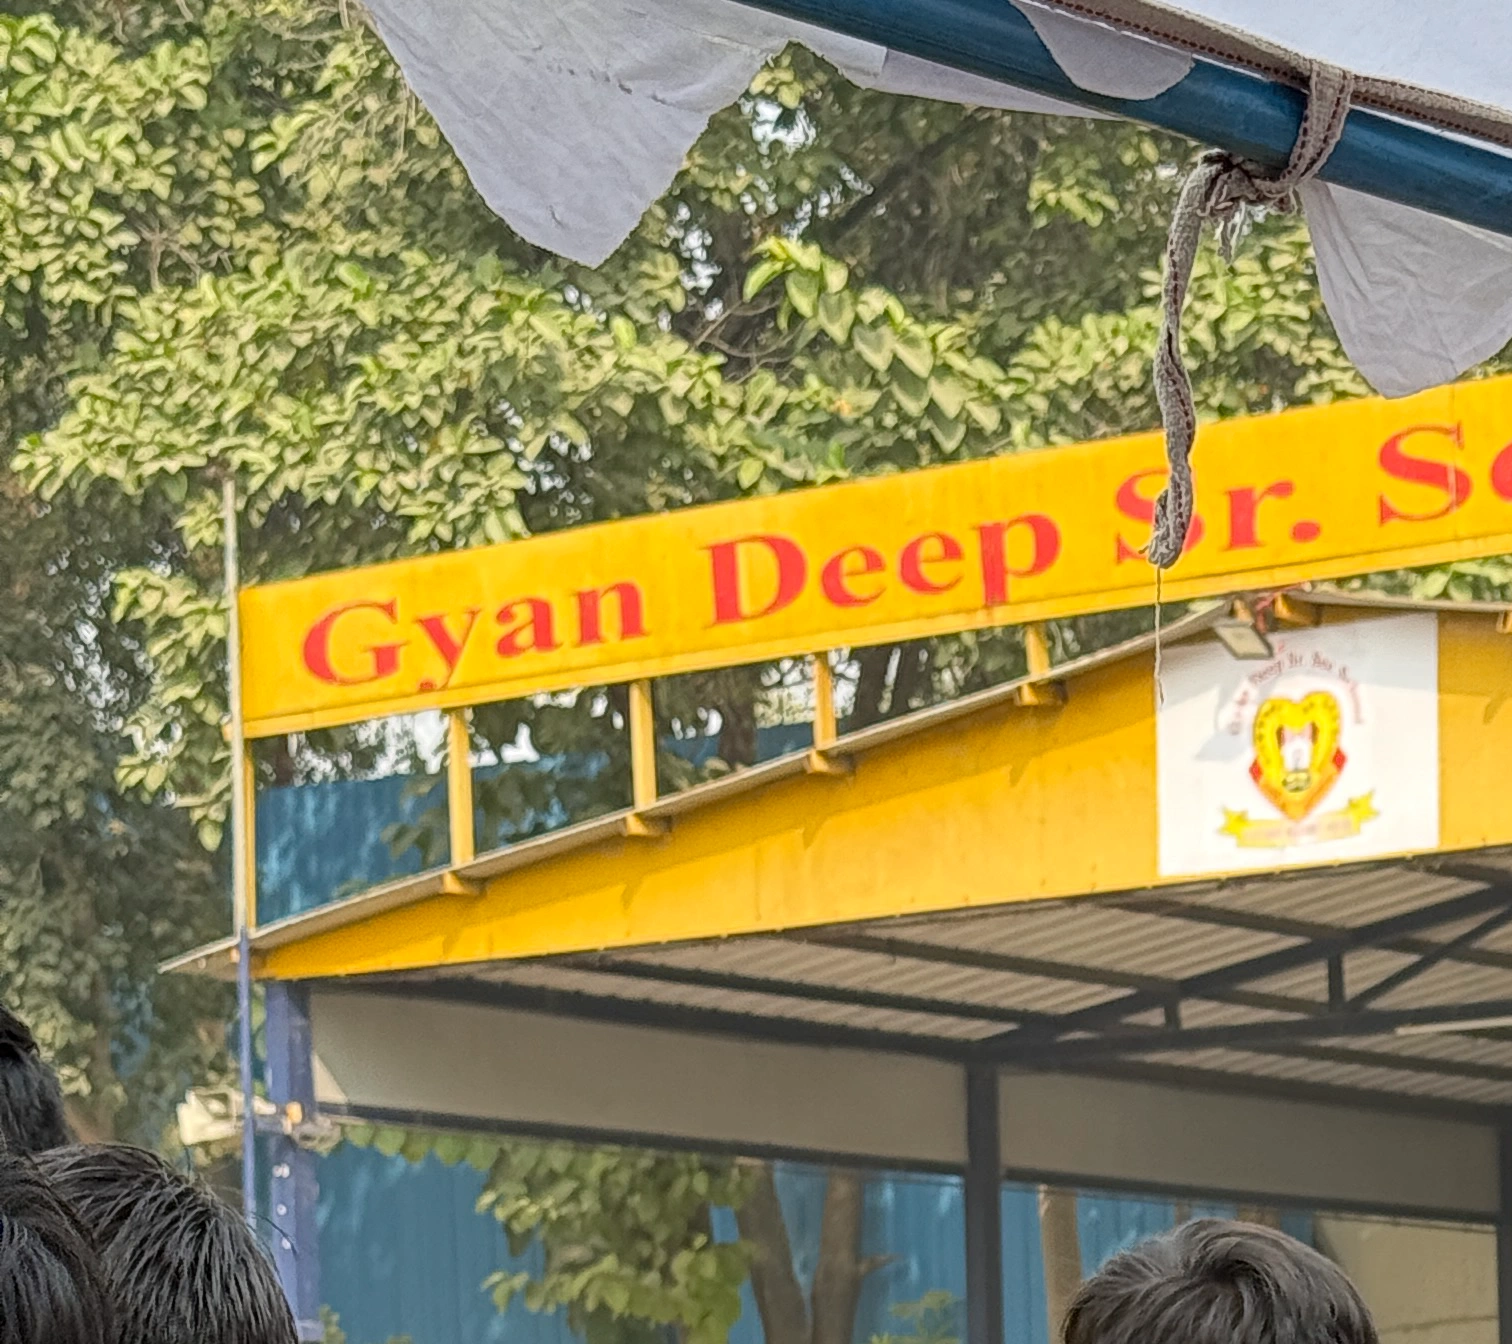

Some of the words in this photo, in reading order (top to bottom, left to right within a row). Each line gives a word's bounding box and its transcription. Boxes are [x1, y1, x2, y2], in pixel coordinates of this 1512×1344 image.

[301, 579, 651, 693] Gyan
[703, 509, 1062, 631] Deep
[1115, 466, 1322, 566] Sr.
